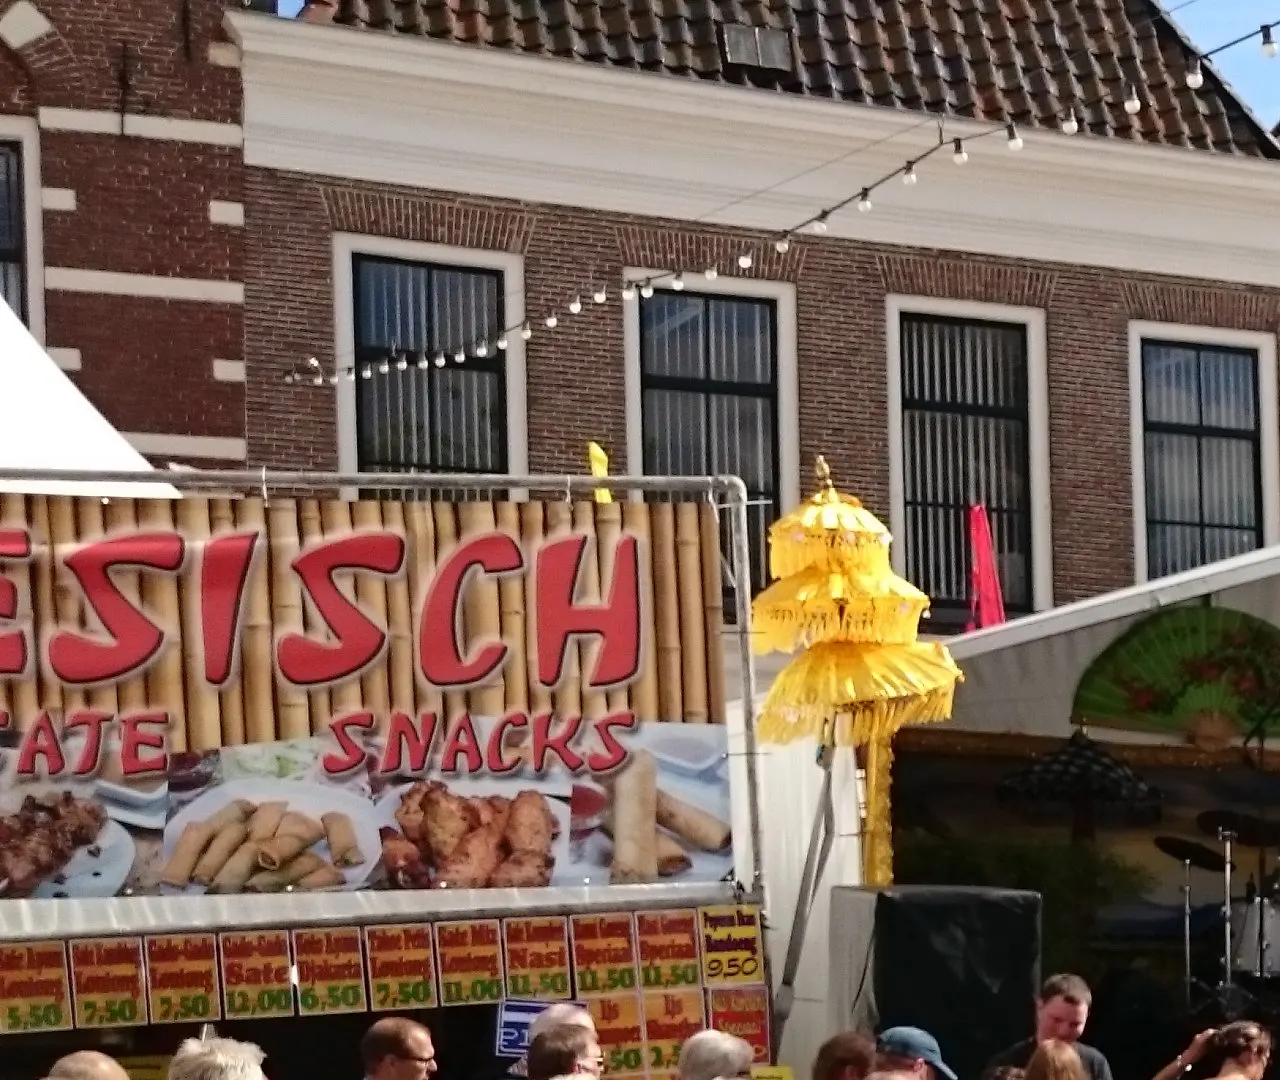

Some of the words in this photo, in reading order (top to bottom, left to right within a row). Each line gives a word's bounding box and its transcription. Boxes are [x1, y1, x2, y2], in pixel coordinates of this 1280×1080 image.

[0, 529, 643, 687] SISCH
[0, 711, 169, 775] ATE
[322, 711, 636, 775] SNACKS
[508, 943, 567, 968] Nasi
[226, 961, 289, 985] Sate
[577, 967, 635, 993] 11,50
[642, 963, 698, 989] 11,50
[227, 989, 292, 1015] 12,00
[300, 984, 361, 1011] 6,50
[376, 981, 430, 1007] 7,50
[84, 1000, 137, 1025] 7,50
[160, 995, 210, 1020] 7,50
